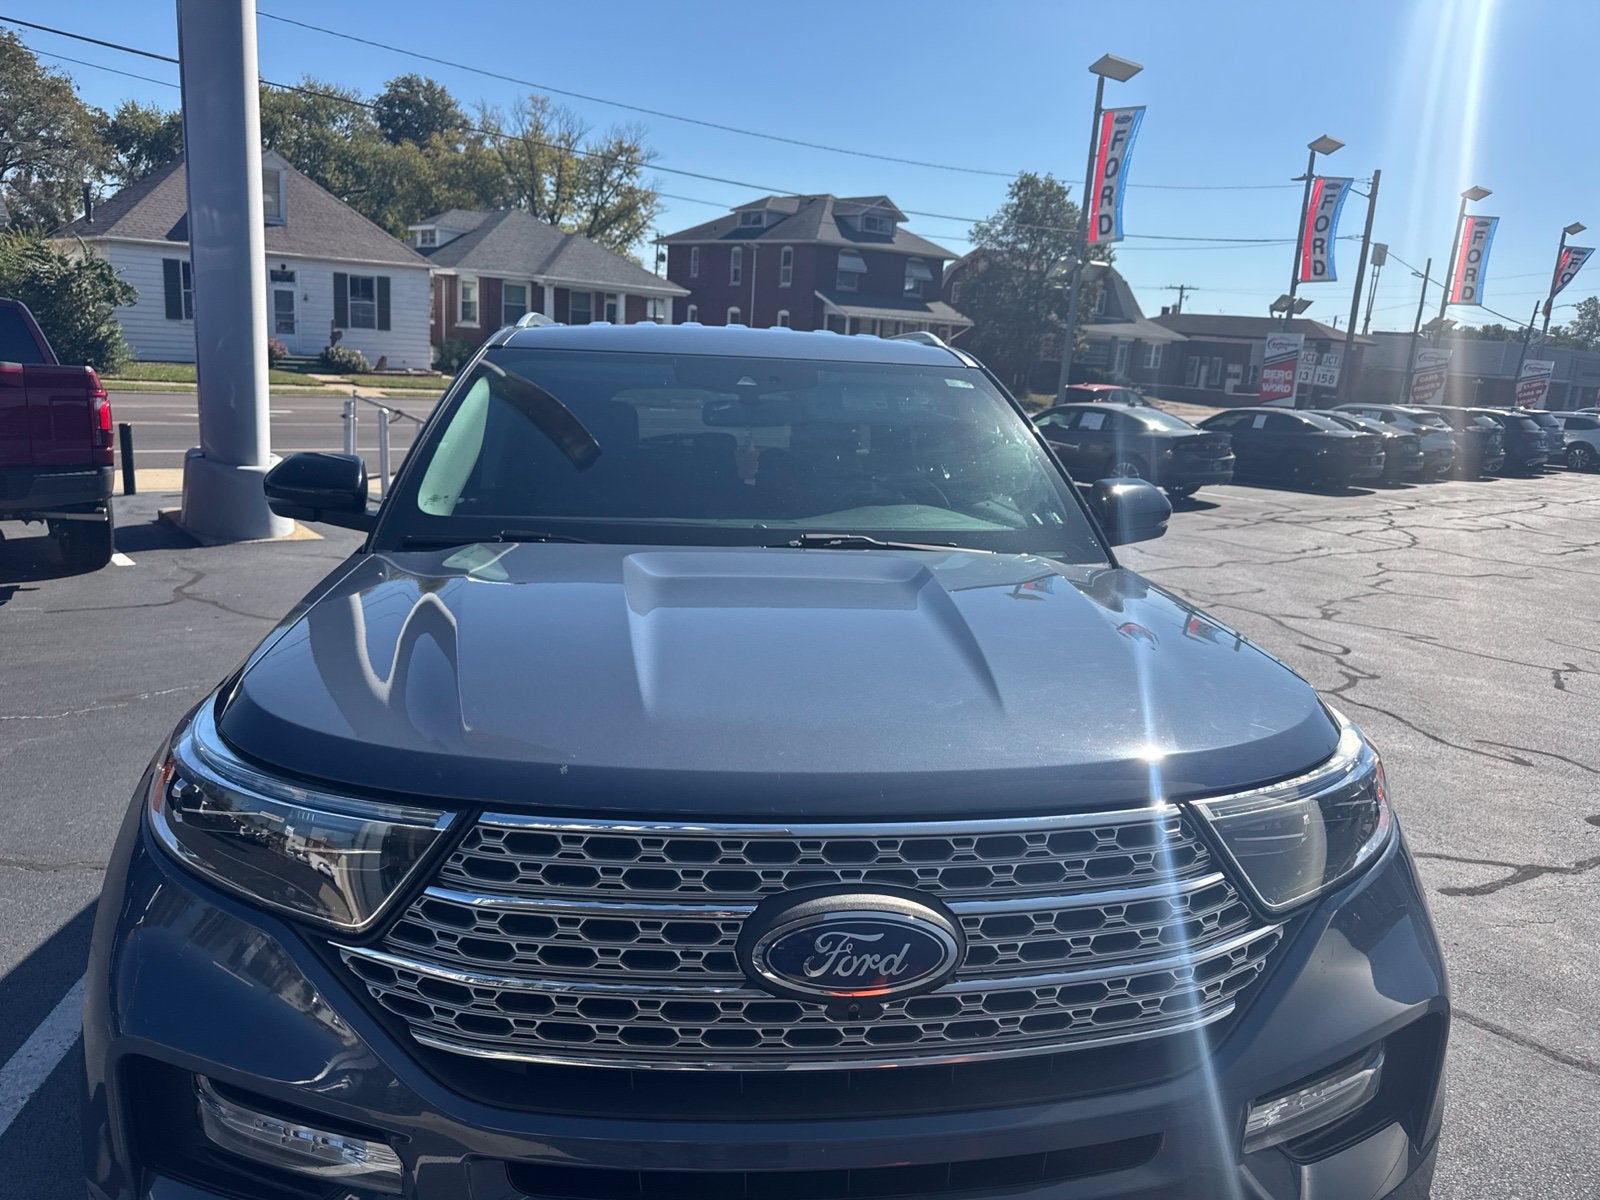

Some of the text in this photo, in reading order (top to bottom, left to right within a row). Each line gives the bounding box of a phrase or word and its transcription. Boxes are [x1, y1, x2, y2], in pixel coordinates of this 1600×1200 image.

[1099, 129, 1127, 235] FORD
[1312, 194, 1337, 276] FORD
[1462, 230, 1486, 300] FORD
[1560, 256, 1582, 285] FO
[1302, 352, 1316, 362] JCT
[1323, 355, 1339, 365] JCT
[1263, 369, 1293, 380] BERG
[1317, 373, 1336, 385] 158
[1262, 382, 1292, 393] WORD
[803, 931, 910, 977] Ford
